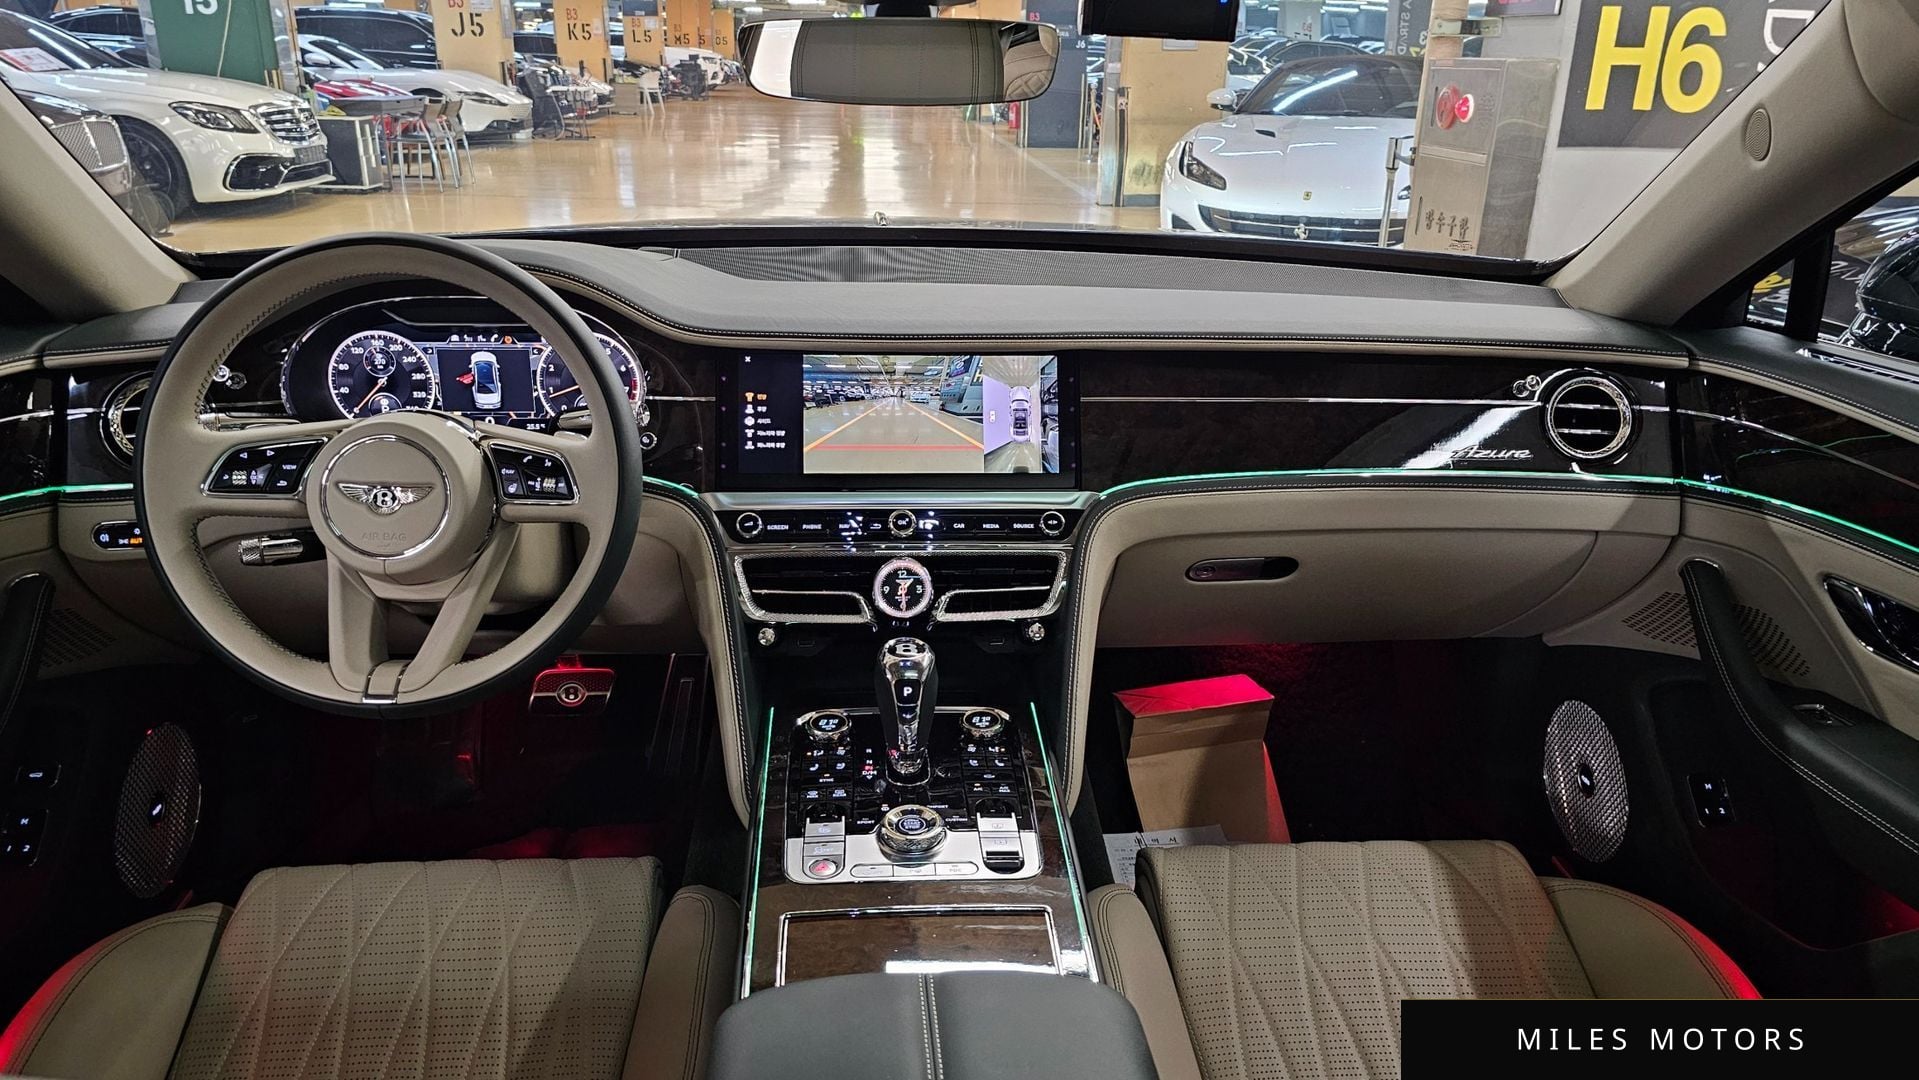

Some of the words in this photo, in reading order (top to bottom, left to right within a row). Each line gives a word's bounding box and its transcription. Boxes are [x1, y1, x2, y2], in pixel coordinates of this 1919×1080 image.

[451, 12, 485, 37] J5
[567, 23, 592, 40] K5
[632, 30, 652, 43] L5
[1076, 40, 1086, 49] J6
[1585, 6, 1727, 113] H6
[1450, 445, 1534, 459] Azure
[362, 532, 378, 540] AIR
[383, 532, 407, 541] BAG
[883, 585, 890, 594] 9
[915, 584, 923, 593] 3
[903, 686, 913, 697] P
